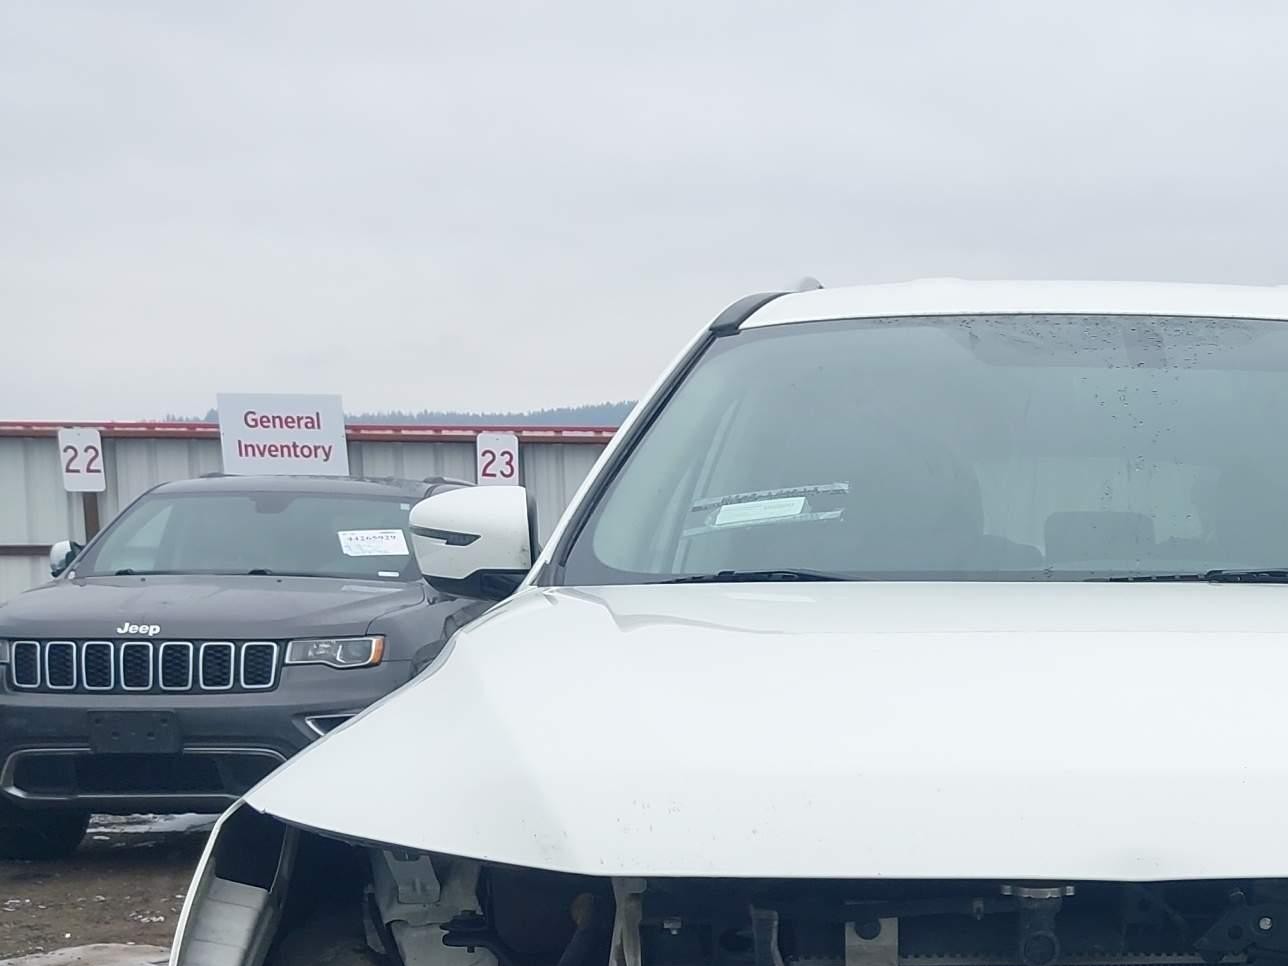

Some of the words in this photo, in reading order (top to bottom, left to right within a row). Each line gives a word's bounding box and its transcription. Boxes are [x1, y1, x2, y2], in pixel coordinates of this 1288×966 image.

[243, 410, 321, 430] General
[63, 445, 102, 474] 22
[237, 439, 333, 463] Inventory
[481, 449, 515, 479] 23
[116, 622, 161, 637] Jeep
